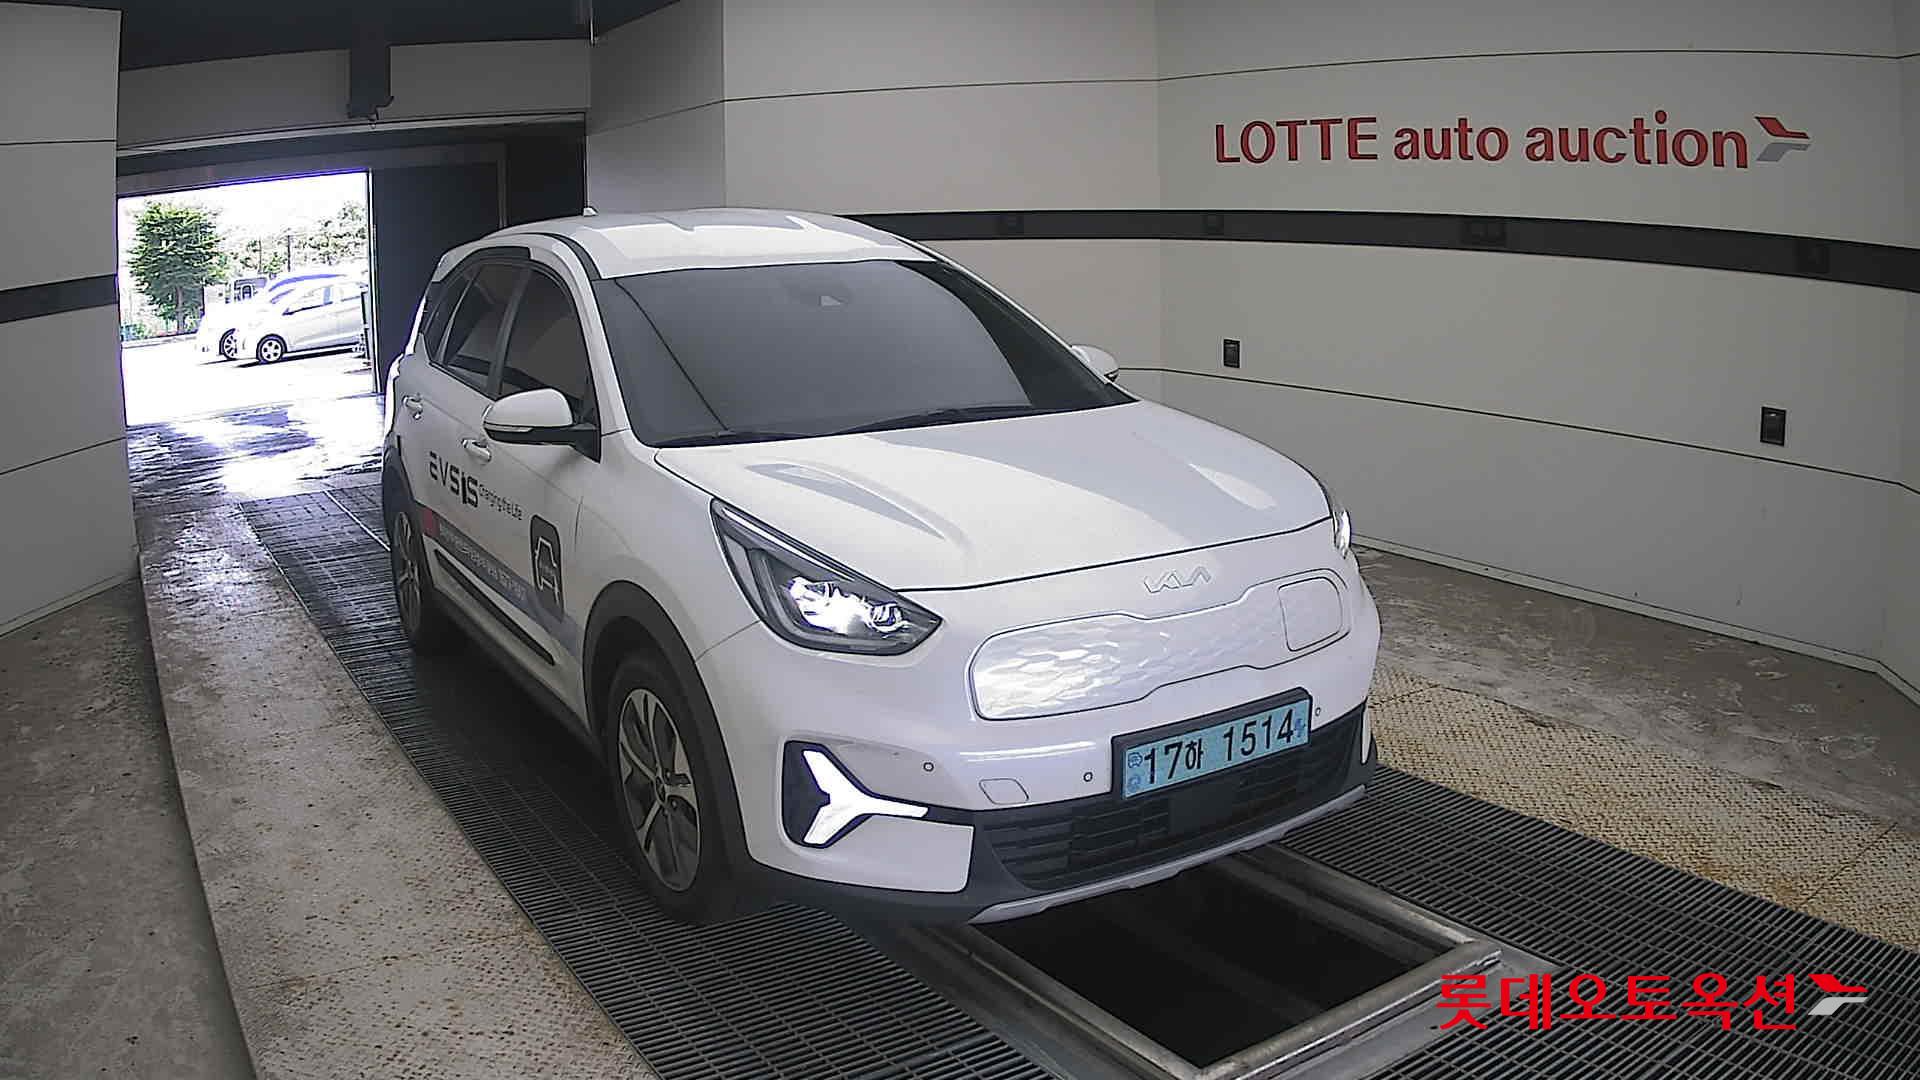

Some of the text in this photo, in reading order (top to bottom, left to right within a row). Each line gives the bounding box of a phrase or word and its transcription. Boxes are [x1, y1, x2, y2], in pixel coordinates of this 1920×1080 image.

[1215, 109, 1749, 169] LOTTE auto auction
[1144, 709, 1295, 784] 17하 1514
